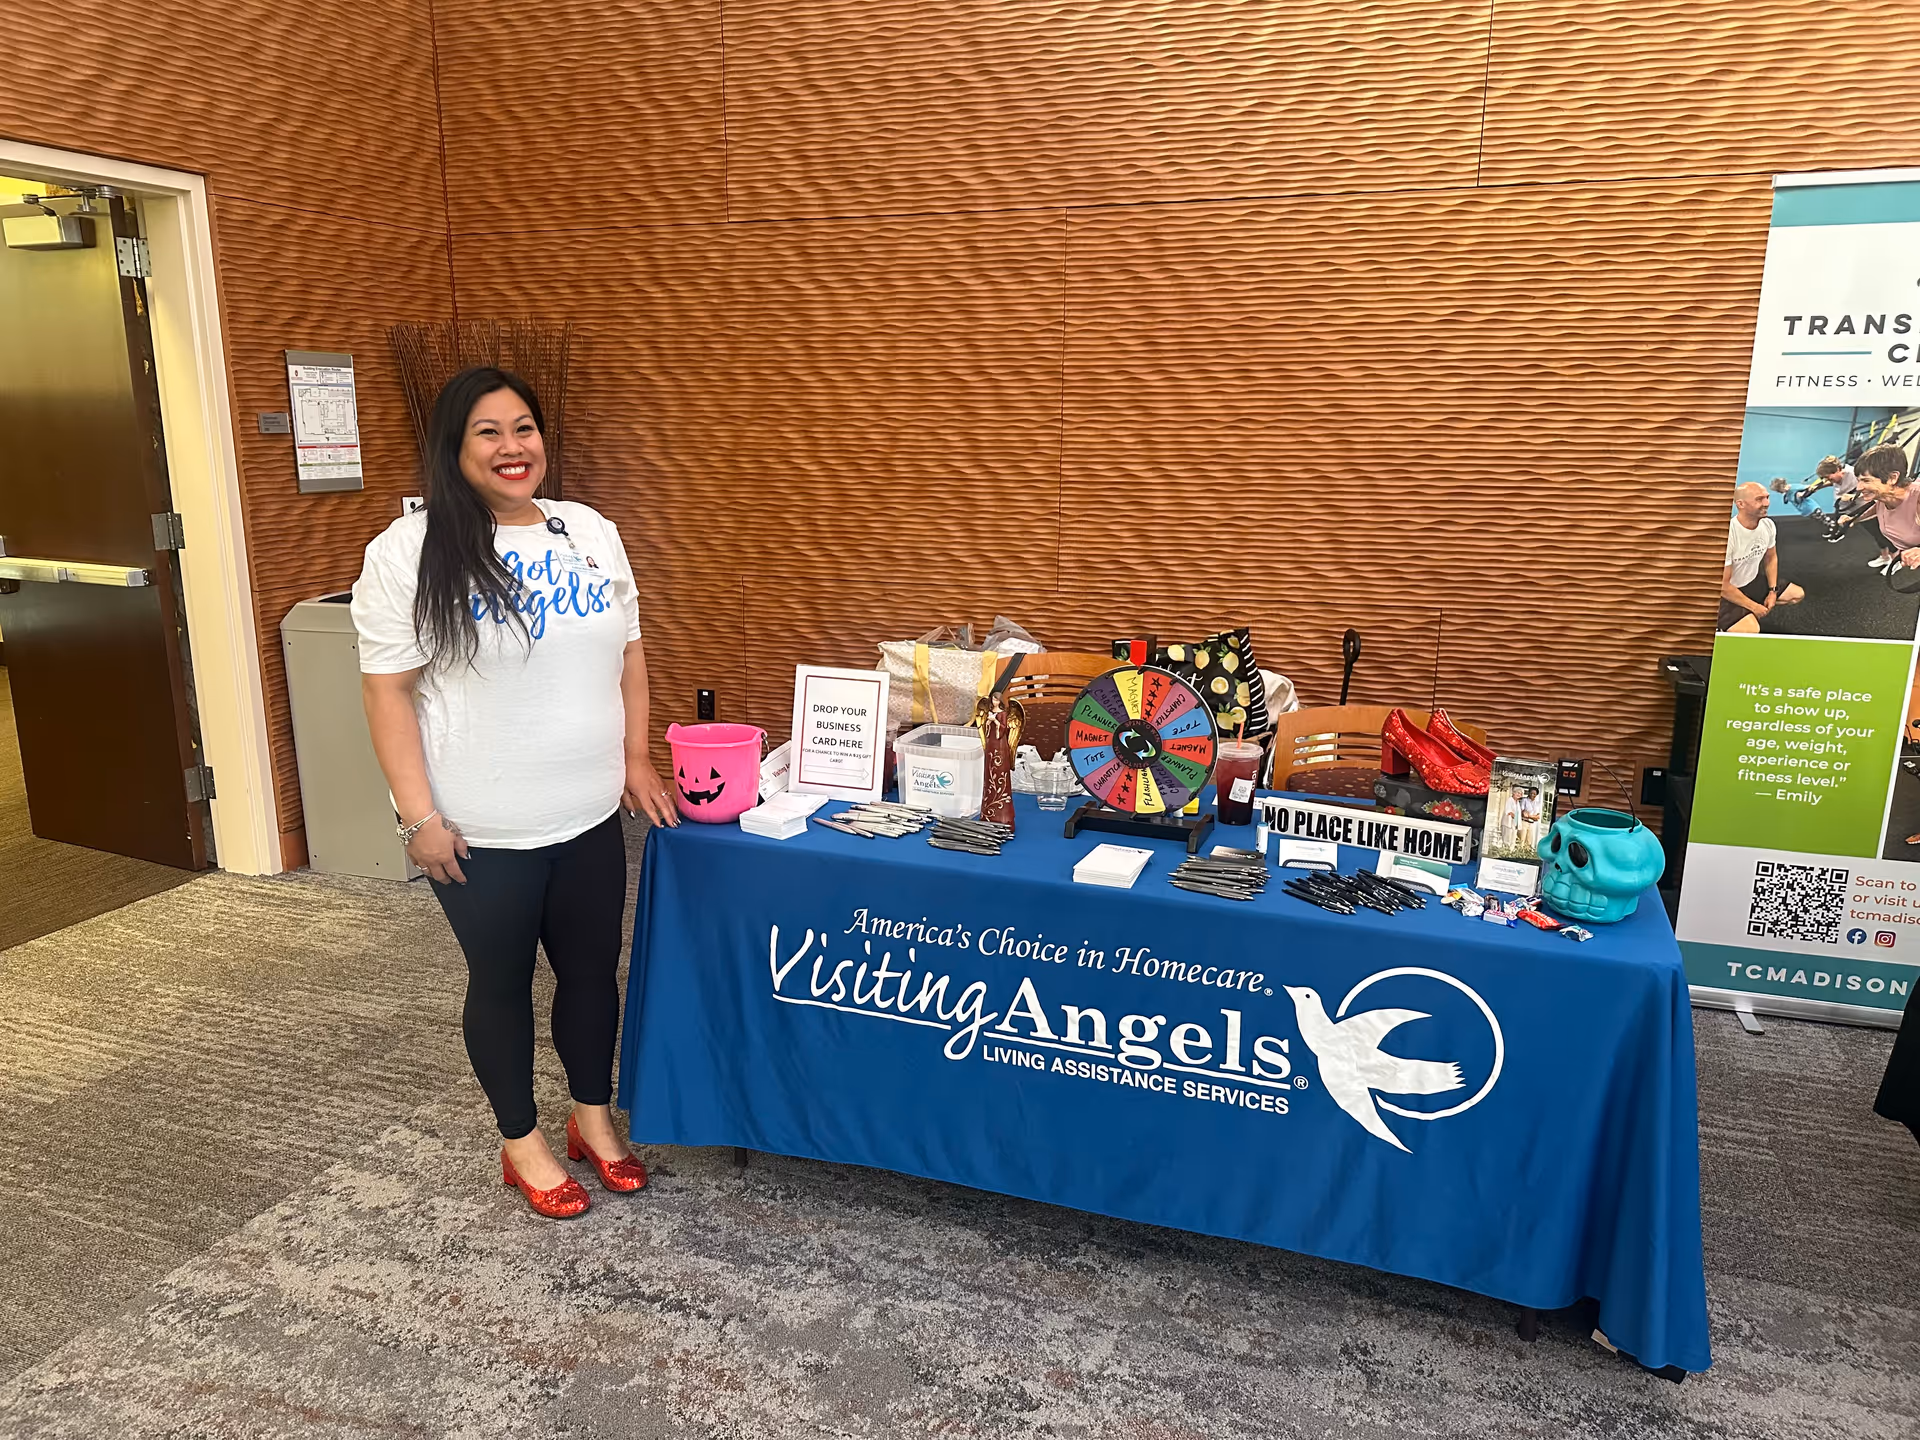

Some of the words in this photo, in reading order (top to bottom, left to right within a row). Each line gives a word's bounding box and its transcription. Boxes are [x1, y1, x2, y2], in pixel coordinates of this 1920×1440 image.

[1783, 313, 1920, 335] TRANS
[1887, 343, 1920, 363] C
[1776, 375, 1858, 387] FITNESS
[1126, 676, 1140, 714] MAGNET
[1739, 683, 1769, 697] "It's
[1773, 687, 1783, 697] a
[1787, 687, 1822, 699] safe
[1826, 689, 1873, 703] place
[813, 704, 839, 714] DROP
[841, 706, 867, 717] YOUR
[1081, 704, 1118, 731] PLANNER
[1155, 693, 1186, 726] CHAPSTICK
[1754, 702, 1771, 713] to
[1774, 703, 1820, 716] show
[1824, 709, 1850, 721] up,
[816, 720, 862, 733] BUSINESS
[1076, 729, 1109, 742] MAGNET
[1172, 720, 1201, 735] TOTE
[1726, 719, 1811, 734] regardless
[1815, 724, 1833, 735] of
[1834, 727, 1875, 739] your
[812, 736, 837, 746] CARD
[839, 739, 863, 749] HERE
[1170, 743, 1207, 754] MAGNET
[1746, 738, 1781, 750] age,
[1785, 740, 1848, 756] weight,
[1084, 750, 1105, 766] TOTE
[1161, 755, 1198, 780] PLANNER
[1738, 754, 1829, 769] experience
[1833, 760, 1851, 771] or
[914, 779, 941, 789] Angels
[1737, 769, 1793, 784] fitness
[1797, 773, 1847, 788] level."
[1776, 789, 1823, 805] Emily
[1264, 805, 1289, 832] NO
[1294, 810, 1353, 843] PLACE
[1357, 820, 1399, 851] LIKE
[1403, 827, 1465, 862] HOME
[1855, 875, 1895, 889] Scan
[1900, 880, 1917, 891] to
[1852, 894, 1870, 904] or
[1874, 894, 1908, 908] visit
[844, 908, 971, 949] America's
[978, 926, 1068, 964] Choice
[1077, 940, 1106, 970] in
[1726, 961, 1909, 996] TCMADISON
[770, 925, 998, 1061] Visiting
[983, 1044, 1045, 1071] LIVING
[1051, 1056, 1177, 1094] ASSISTANCE
[1183, 1080, 1289, 1115] SERVICES
